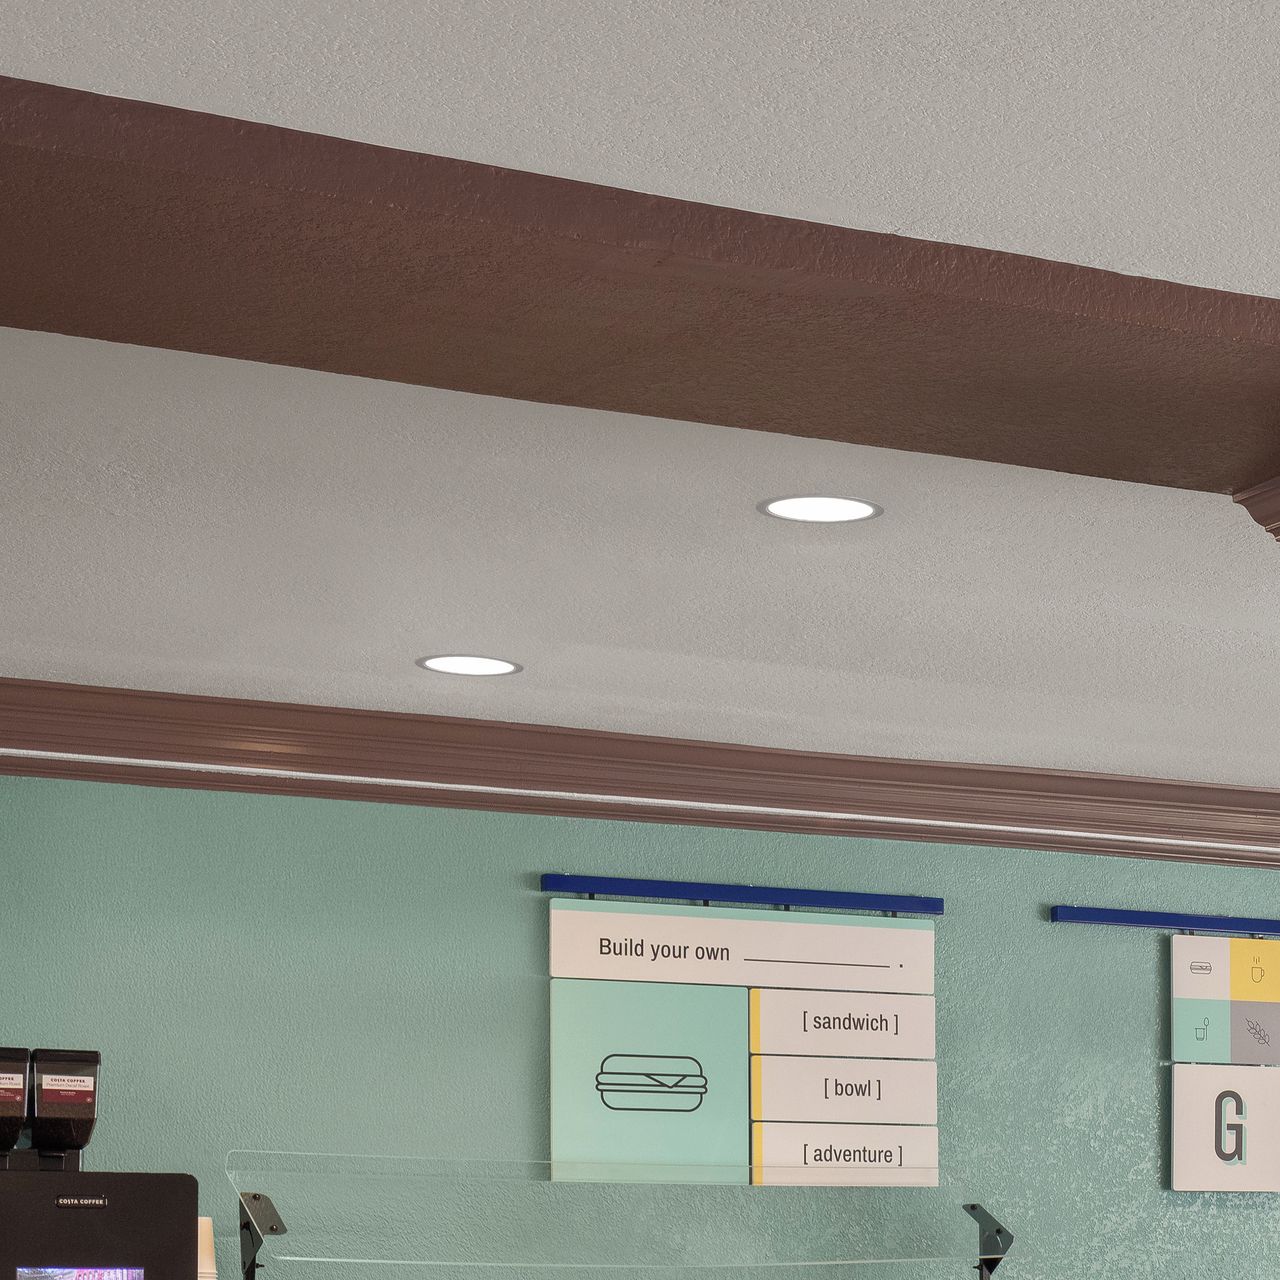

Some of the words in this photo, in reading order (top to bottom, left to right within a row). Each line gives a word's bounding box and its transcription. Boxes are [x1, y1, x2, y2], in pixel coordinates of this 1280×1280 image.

[599, 937, 645, 957] Build
[650, 943, 690, 962] your
[695, 946, 730, 961] own
[812, 1012, 889, 1032] sandwich
[834, 1078, 872, 1097] bowl
[1214, 1089, 1247, 1165] G
[813, 1144, 893, 1164] adventure
